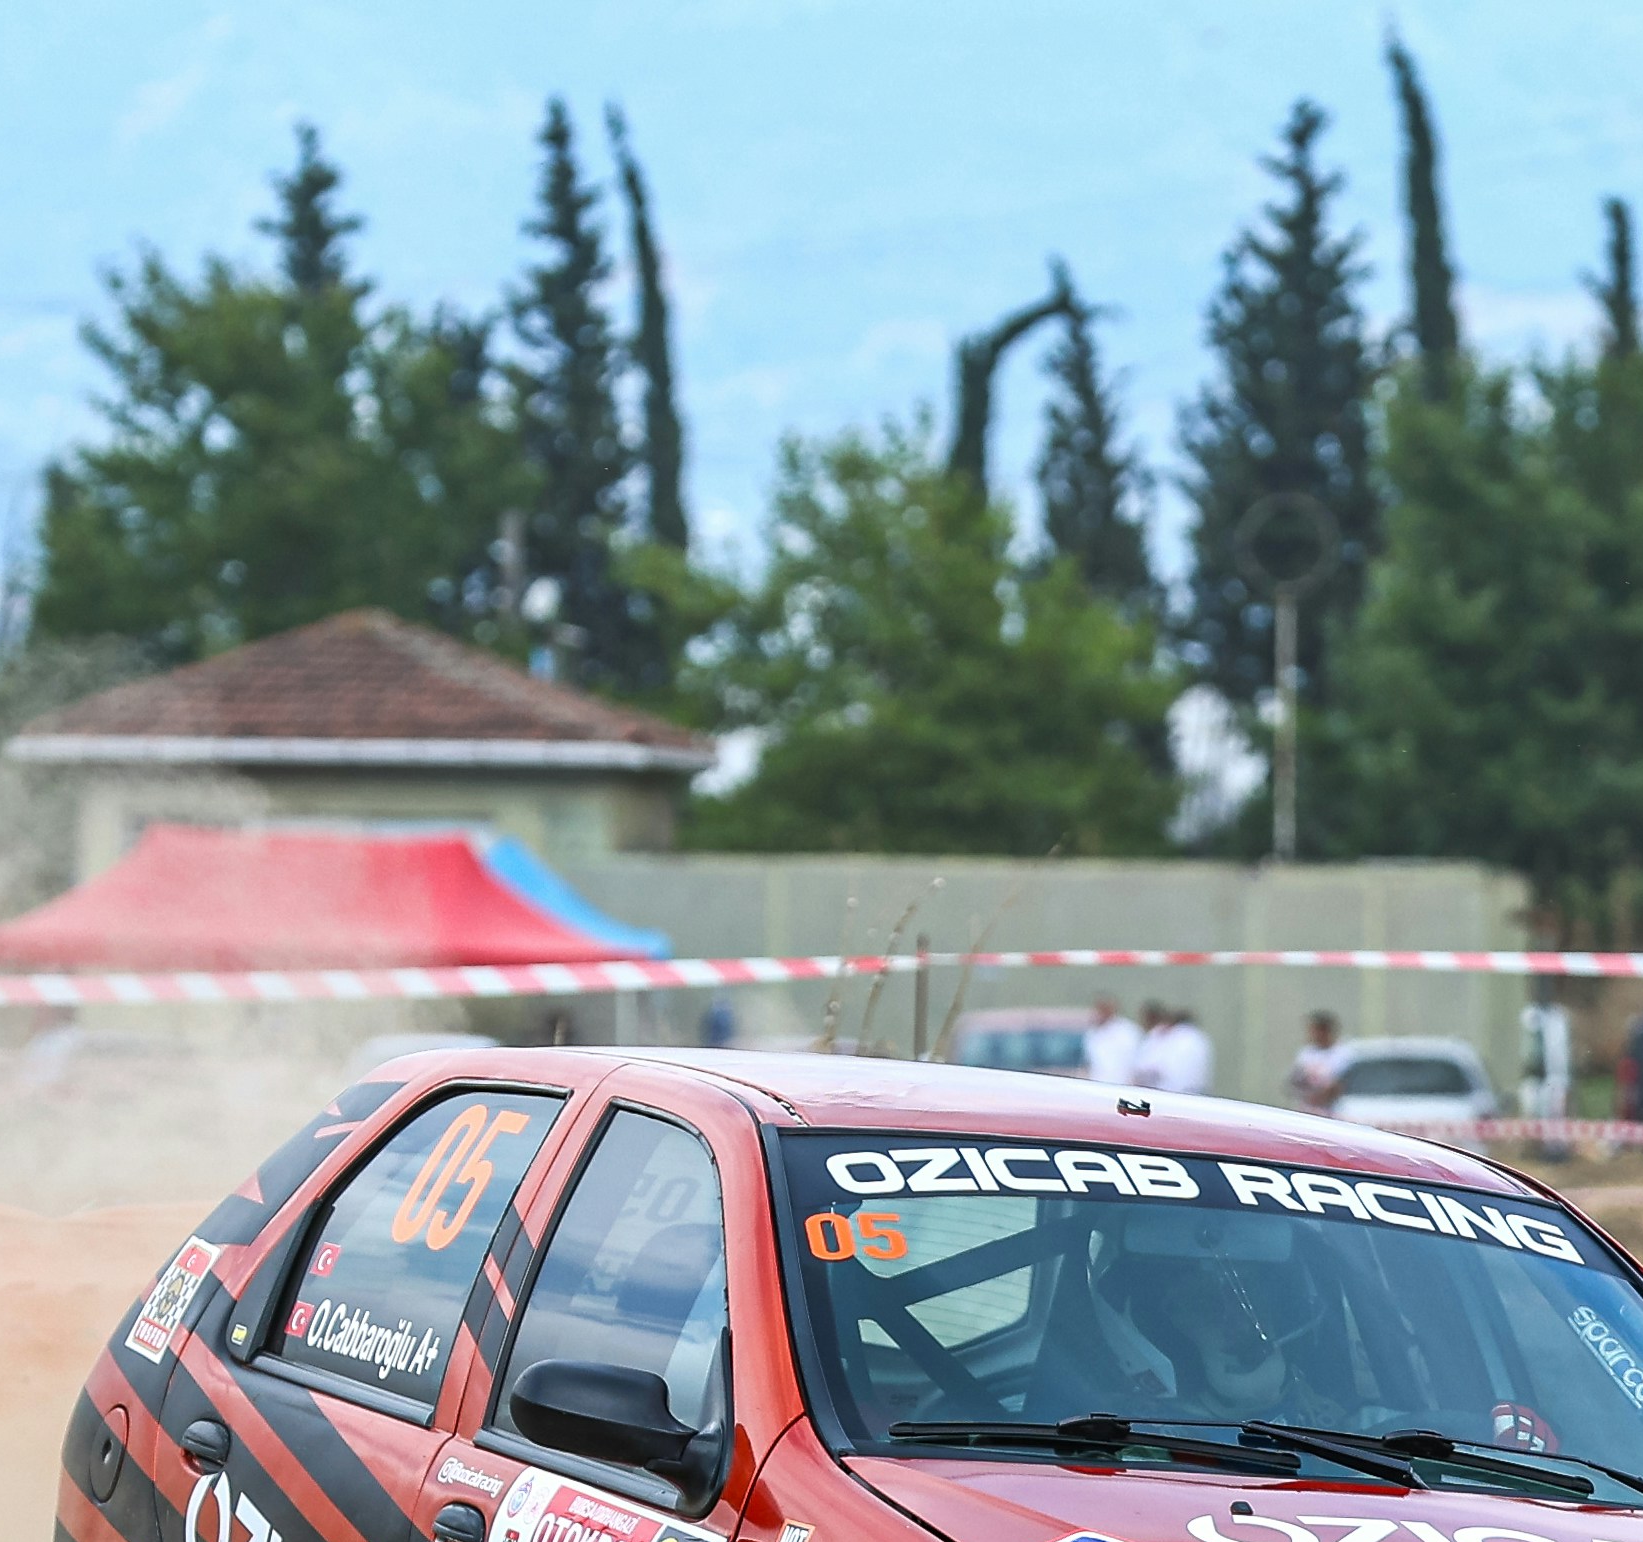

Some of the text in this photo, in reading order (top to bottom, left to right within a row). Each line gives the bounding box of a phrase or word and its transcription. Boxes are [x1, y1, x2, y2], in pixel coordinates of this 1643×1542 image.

[392, 1104, 531, 1250] 05
[826, 1147, 1586, 1265] OZICAB RACING
[804, 1212, 909, 1262] 05
[407, 1327, 440, 1375] A+
